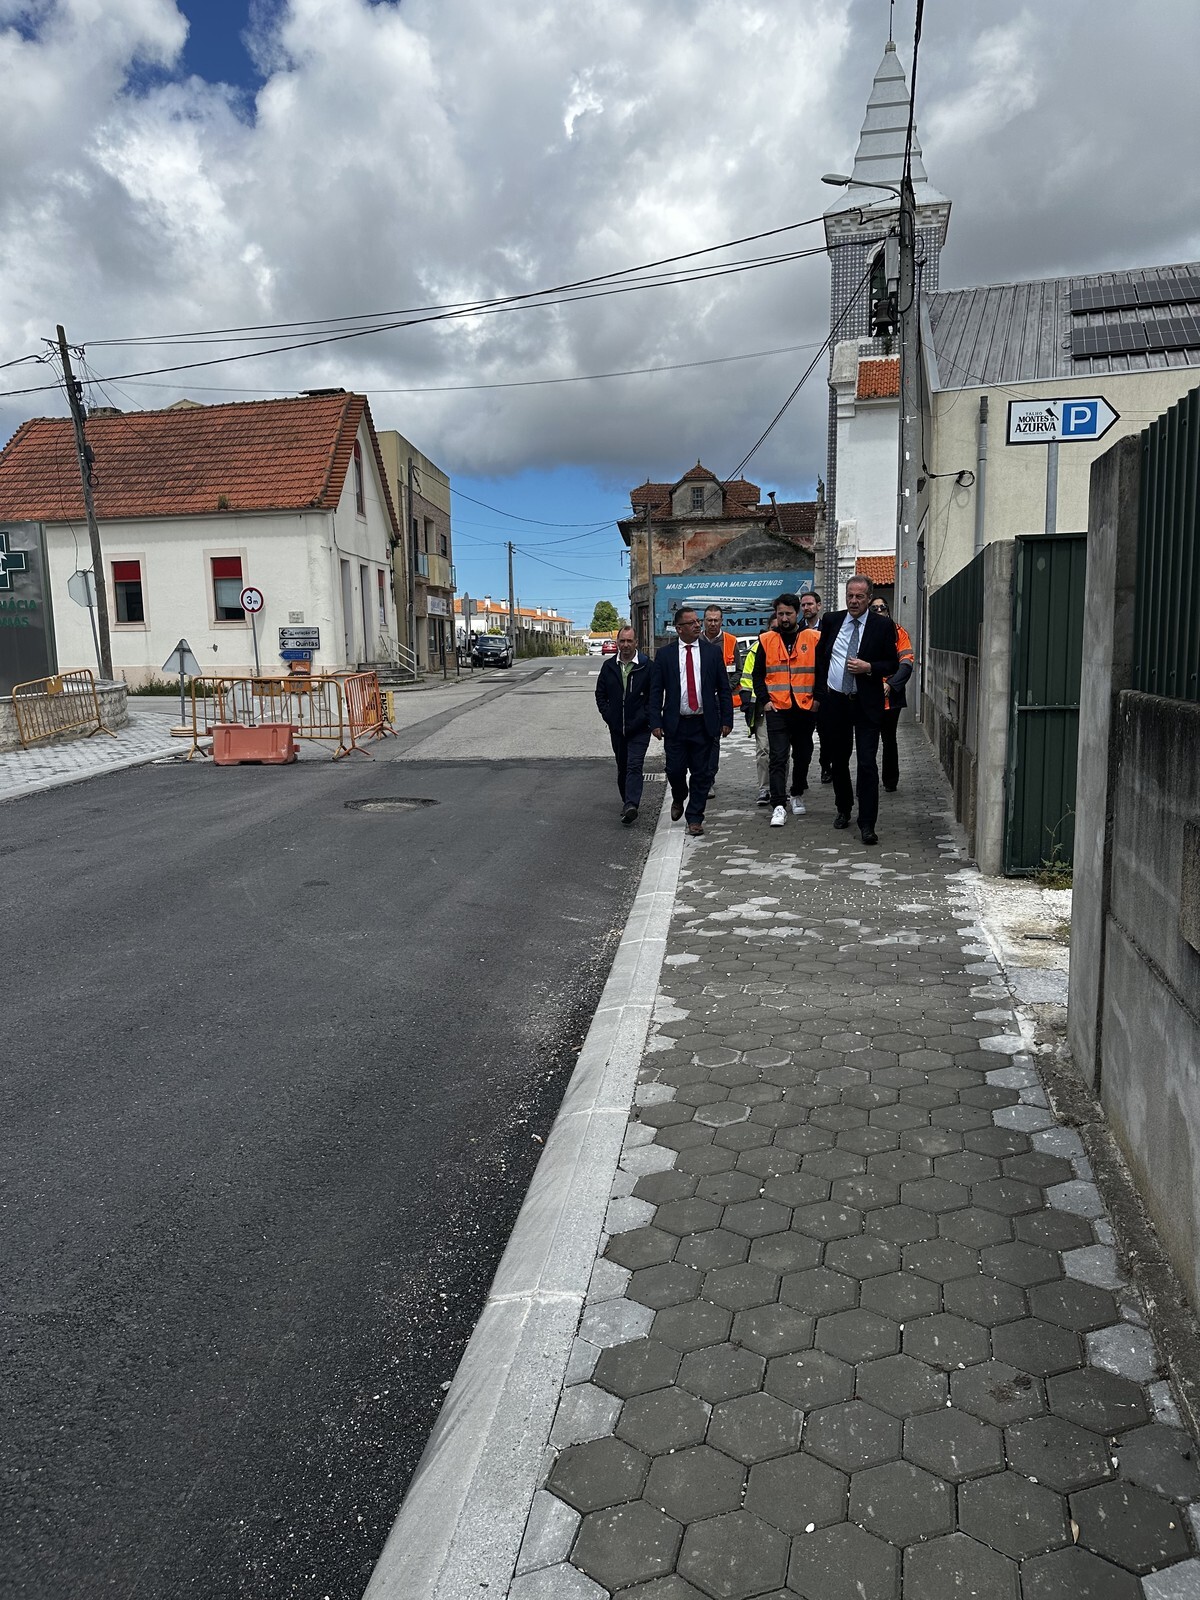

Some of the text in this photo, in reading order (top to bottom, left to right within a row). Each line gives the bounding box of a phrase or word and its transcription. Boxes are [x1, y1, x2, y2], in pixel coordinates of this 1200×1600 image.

[1018, 415, 1049, 423] MONTES
[1070, 406, 1092, 432] P
[1014, 422, 1057, 433] AZURVA
[747, 579, 784, 587] DESTINOS
[0, 615, 29, 626] MÁS
